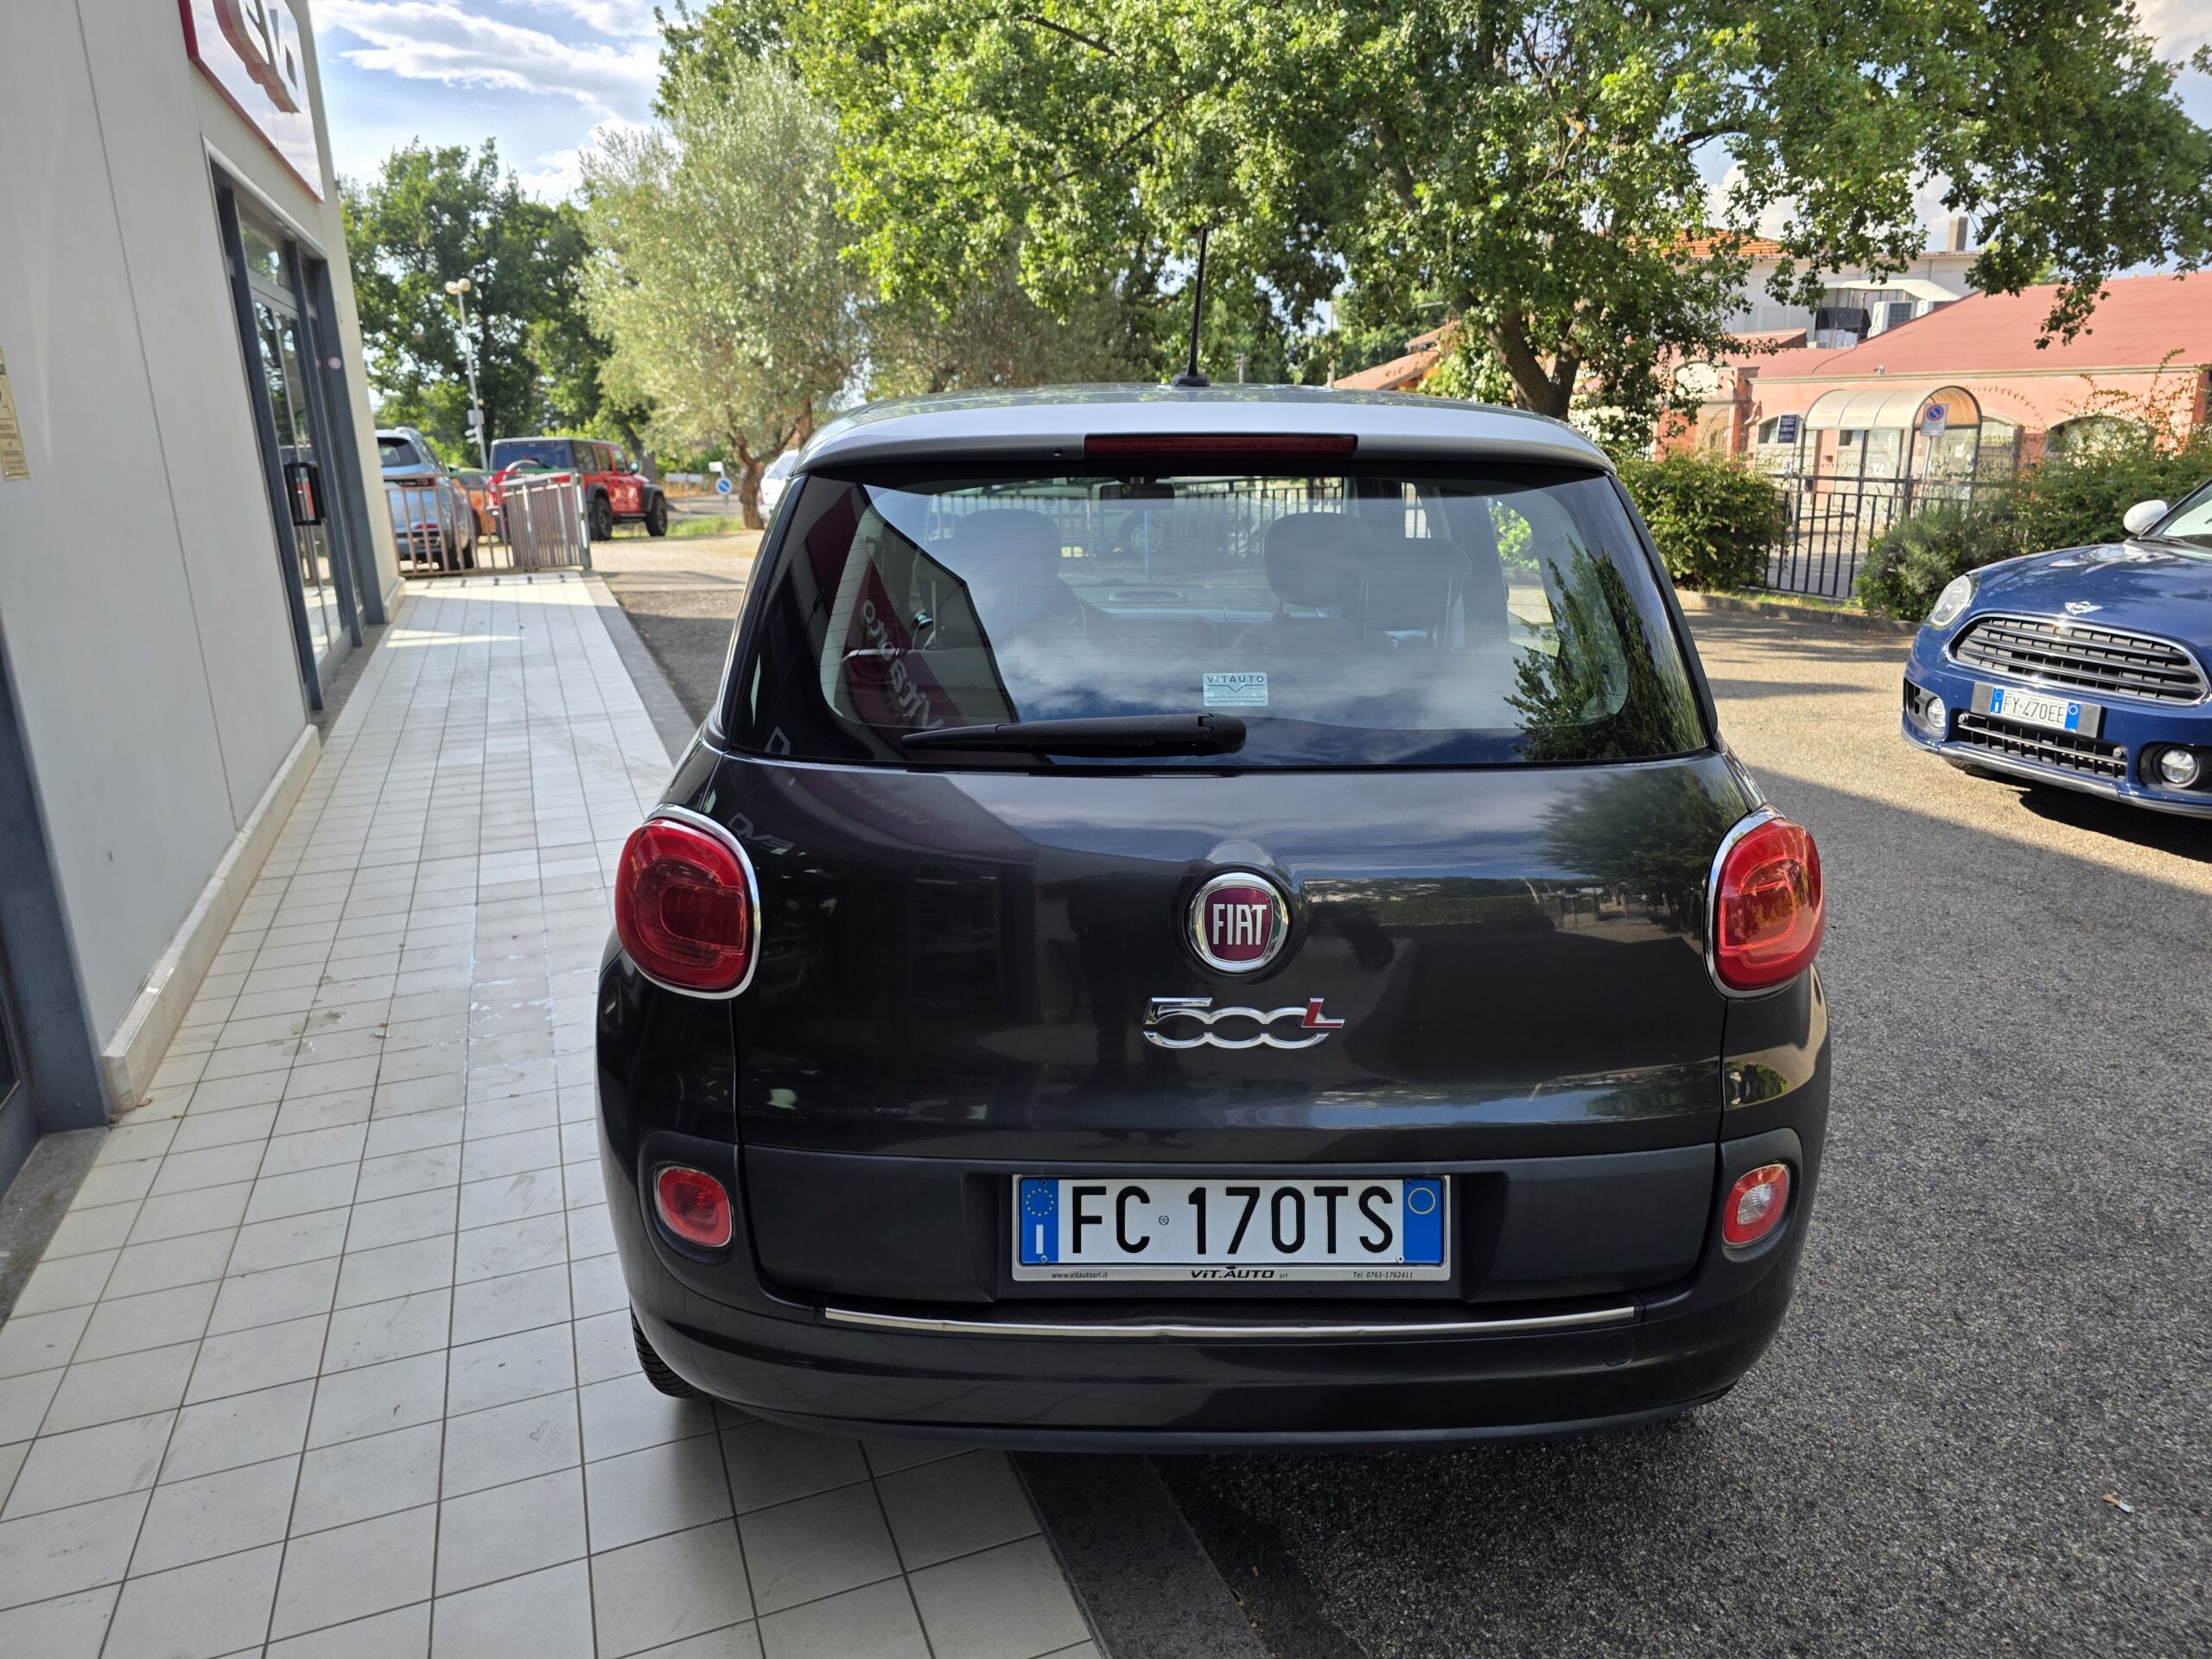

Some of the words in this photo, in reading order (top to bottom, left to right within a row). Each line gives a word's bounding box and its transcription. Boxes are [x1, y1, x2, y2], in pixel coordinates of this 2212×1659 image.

[2003, 695, 2020, 714] FY
[2023, 701, 2066, 723] 470EE
[1212, 904, 1268, 945] FIAT
[1142, 997, 1345, 1050] 500L
[1071, 1185, 1151, 1255] FC
[1187, 1185, 1394, 1255] 170TS
